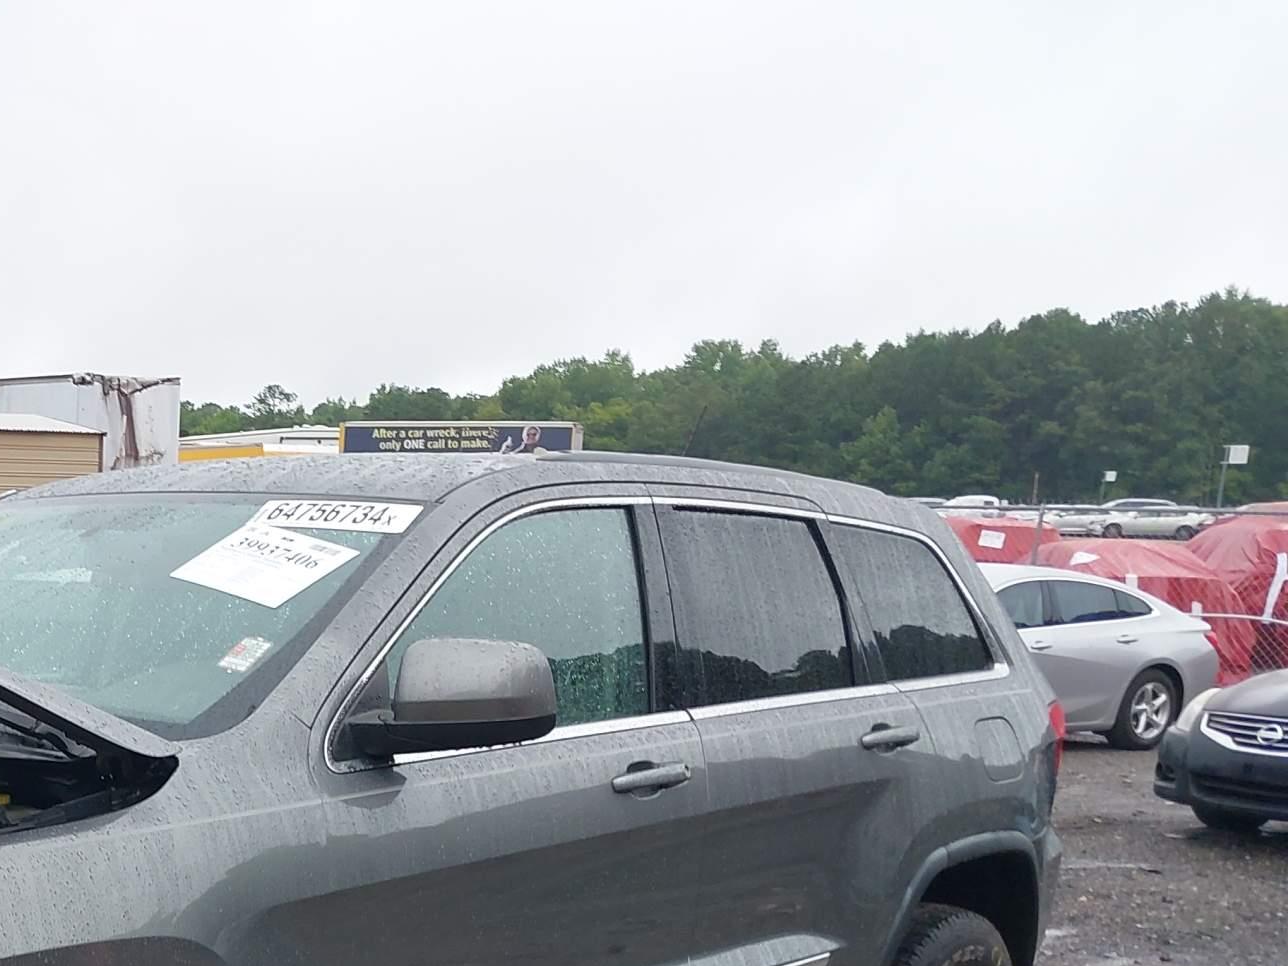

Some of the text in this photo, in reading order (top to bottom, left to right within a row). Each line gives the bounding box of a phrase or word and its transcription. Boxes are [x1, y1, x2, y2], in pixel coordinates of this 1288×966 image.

[372, 428, 397, 438] After
[398, 430, 406, 438] a
[407, 430, 425, 438] car
[426, 427, 459, 439] wreck,
[379, 438, 491, 451] only ONE call to make.
